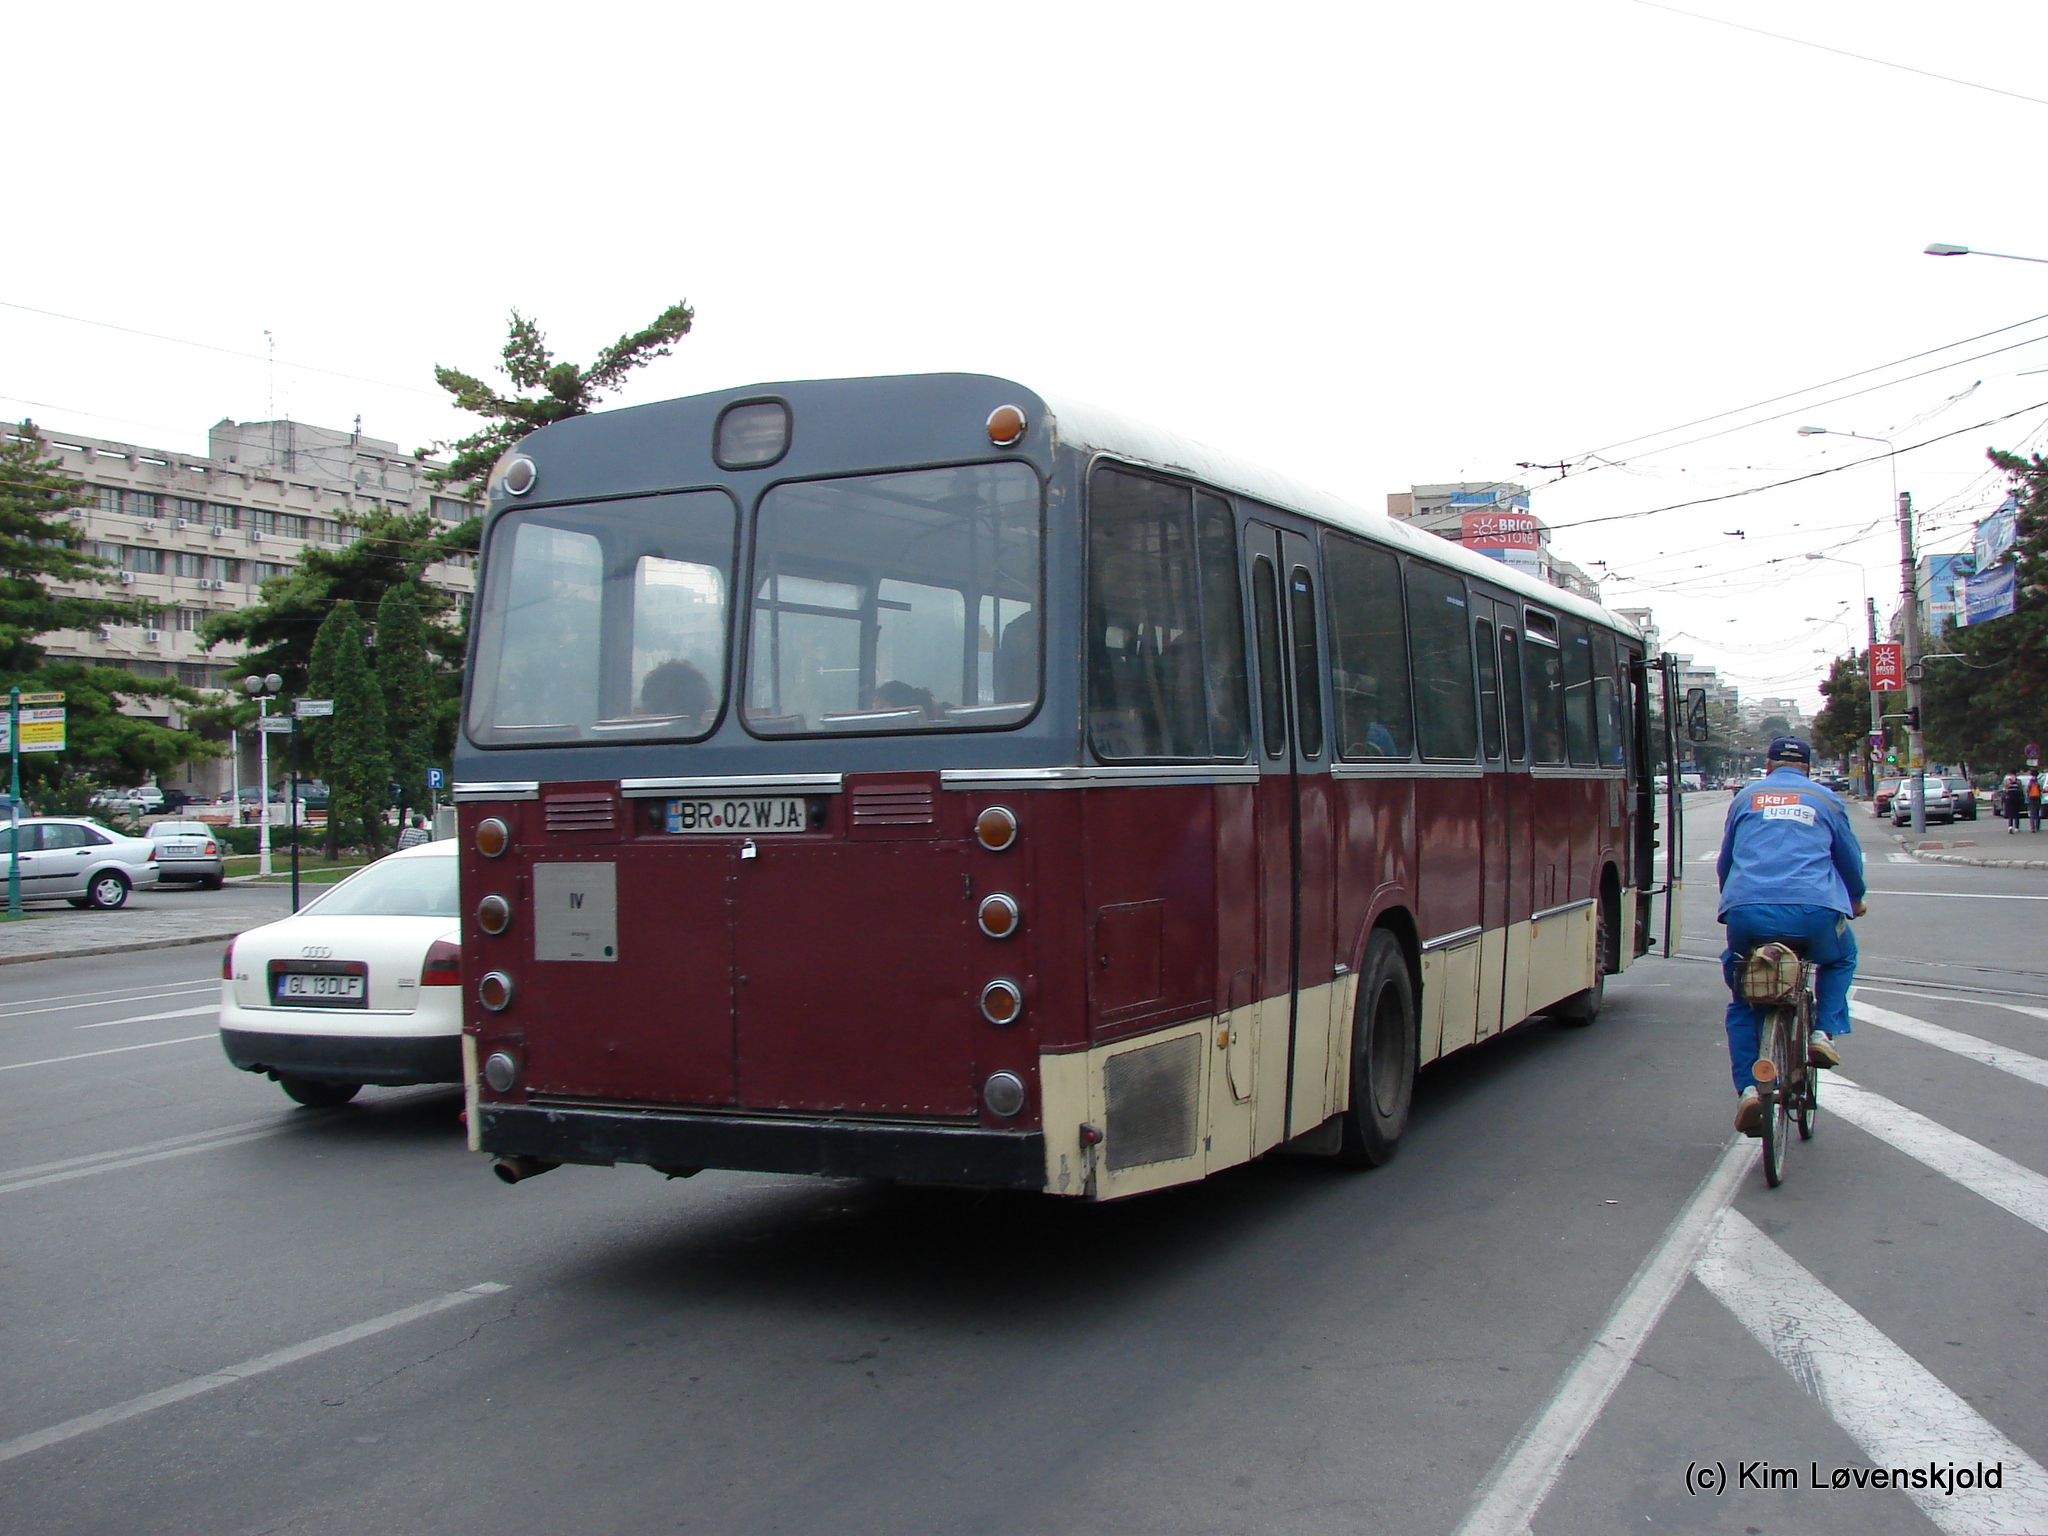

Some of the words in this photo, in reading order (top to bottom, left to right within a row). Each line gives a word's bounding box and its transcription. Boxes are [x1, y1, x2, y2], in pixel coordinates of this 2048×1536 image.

[1499, 518, 1533, 531] BRICO
[430, 770, 441, 786] P
[1756, 795, 1788, 805] aker
[682, 802, 713, 828] BR
[1770, 807, 1810, 819] yards
[289, 977, 311, 993] GL
